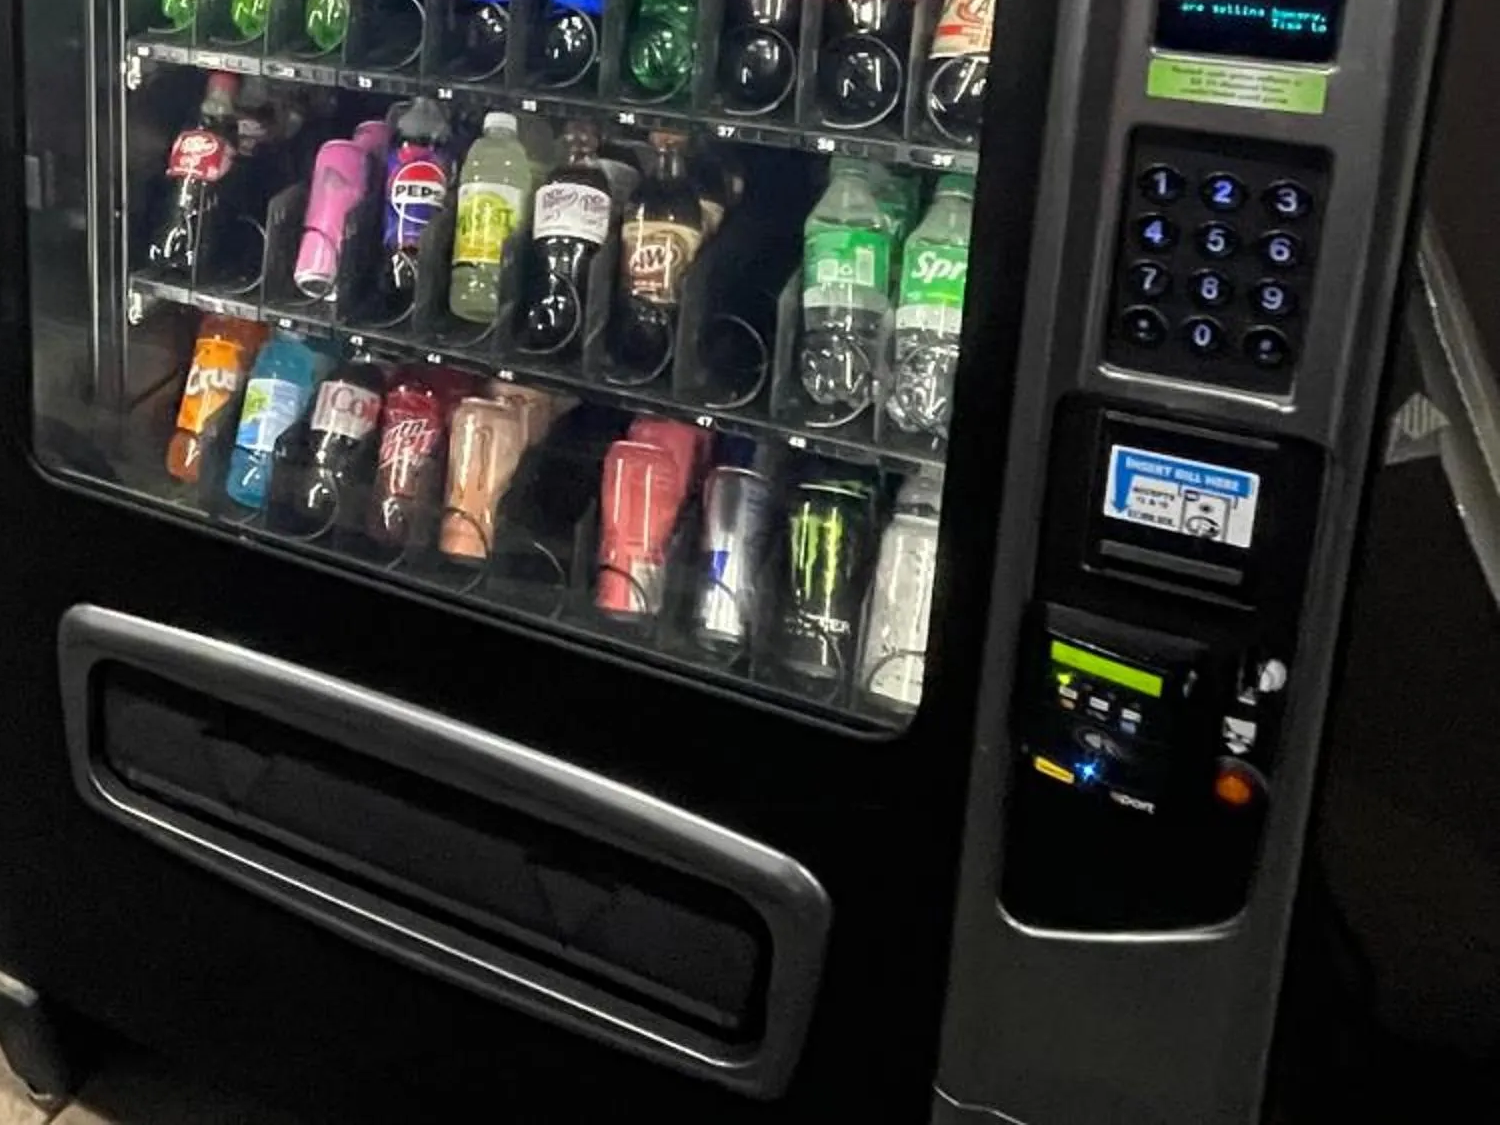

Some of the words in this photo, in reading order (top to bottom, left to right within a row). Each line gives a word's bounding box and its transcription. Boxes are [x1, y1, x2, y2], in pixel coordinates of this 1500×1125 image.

[395, 184, 445, 202] PEPS
[1154, 173, 1166, 195] 1
[1213, 180, 1232, 203] 2
[1276, 188, 1297, 213] 3
[1144, 220, 1163, 244] 4
[1207, 228, 1225, 252] 5
[1269, 238, 1292, 262] 6
[911, 250, 968, 284] Spr
[1140, 266, 1157, 290] 7
[1202, 277, 1219, 300] 8
[1261, 286, 1284, 310] 9
[1193, 324, 1212, 348] 0
[185, 362, 236, 396] Crus
[696, 415, 714, 428] 47
